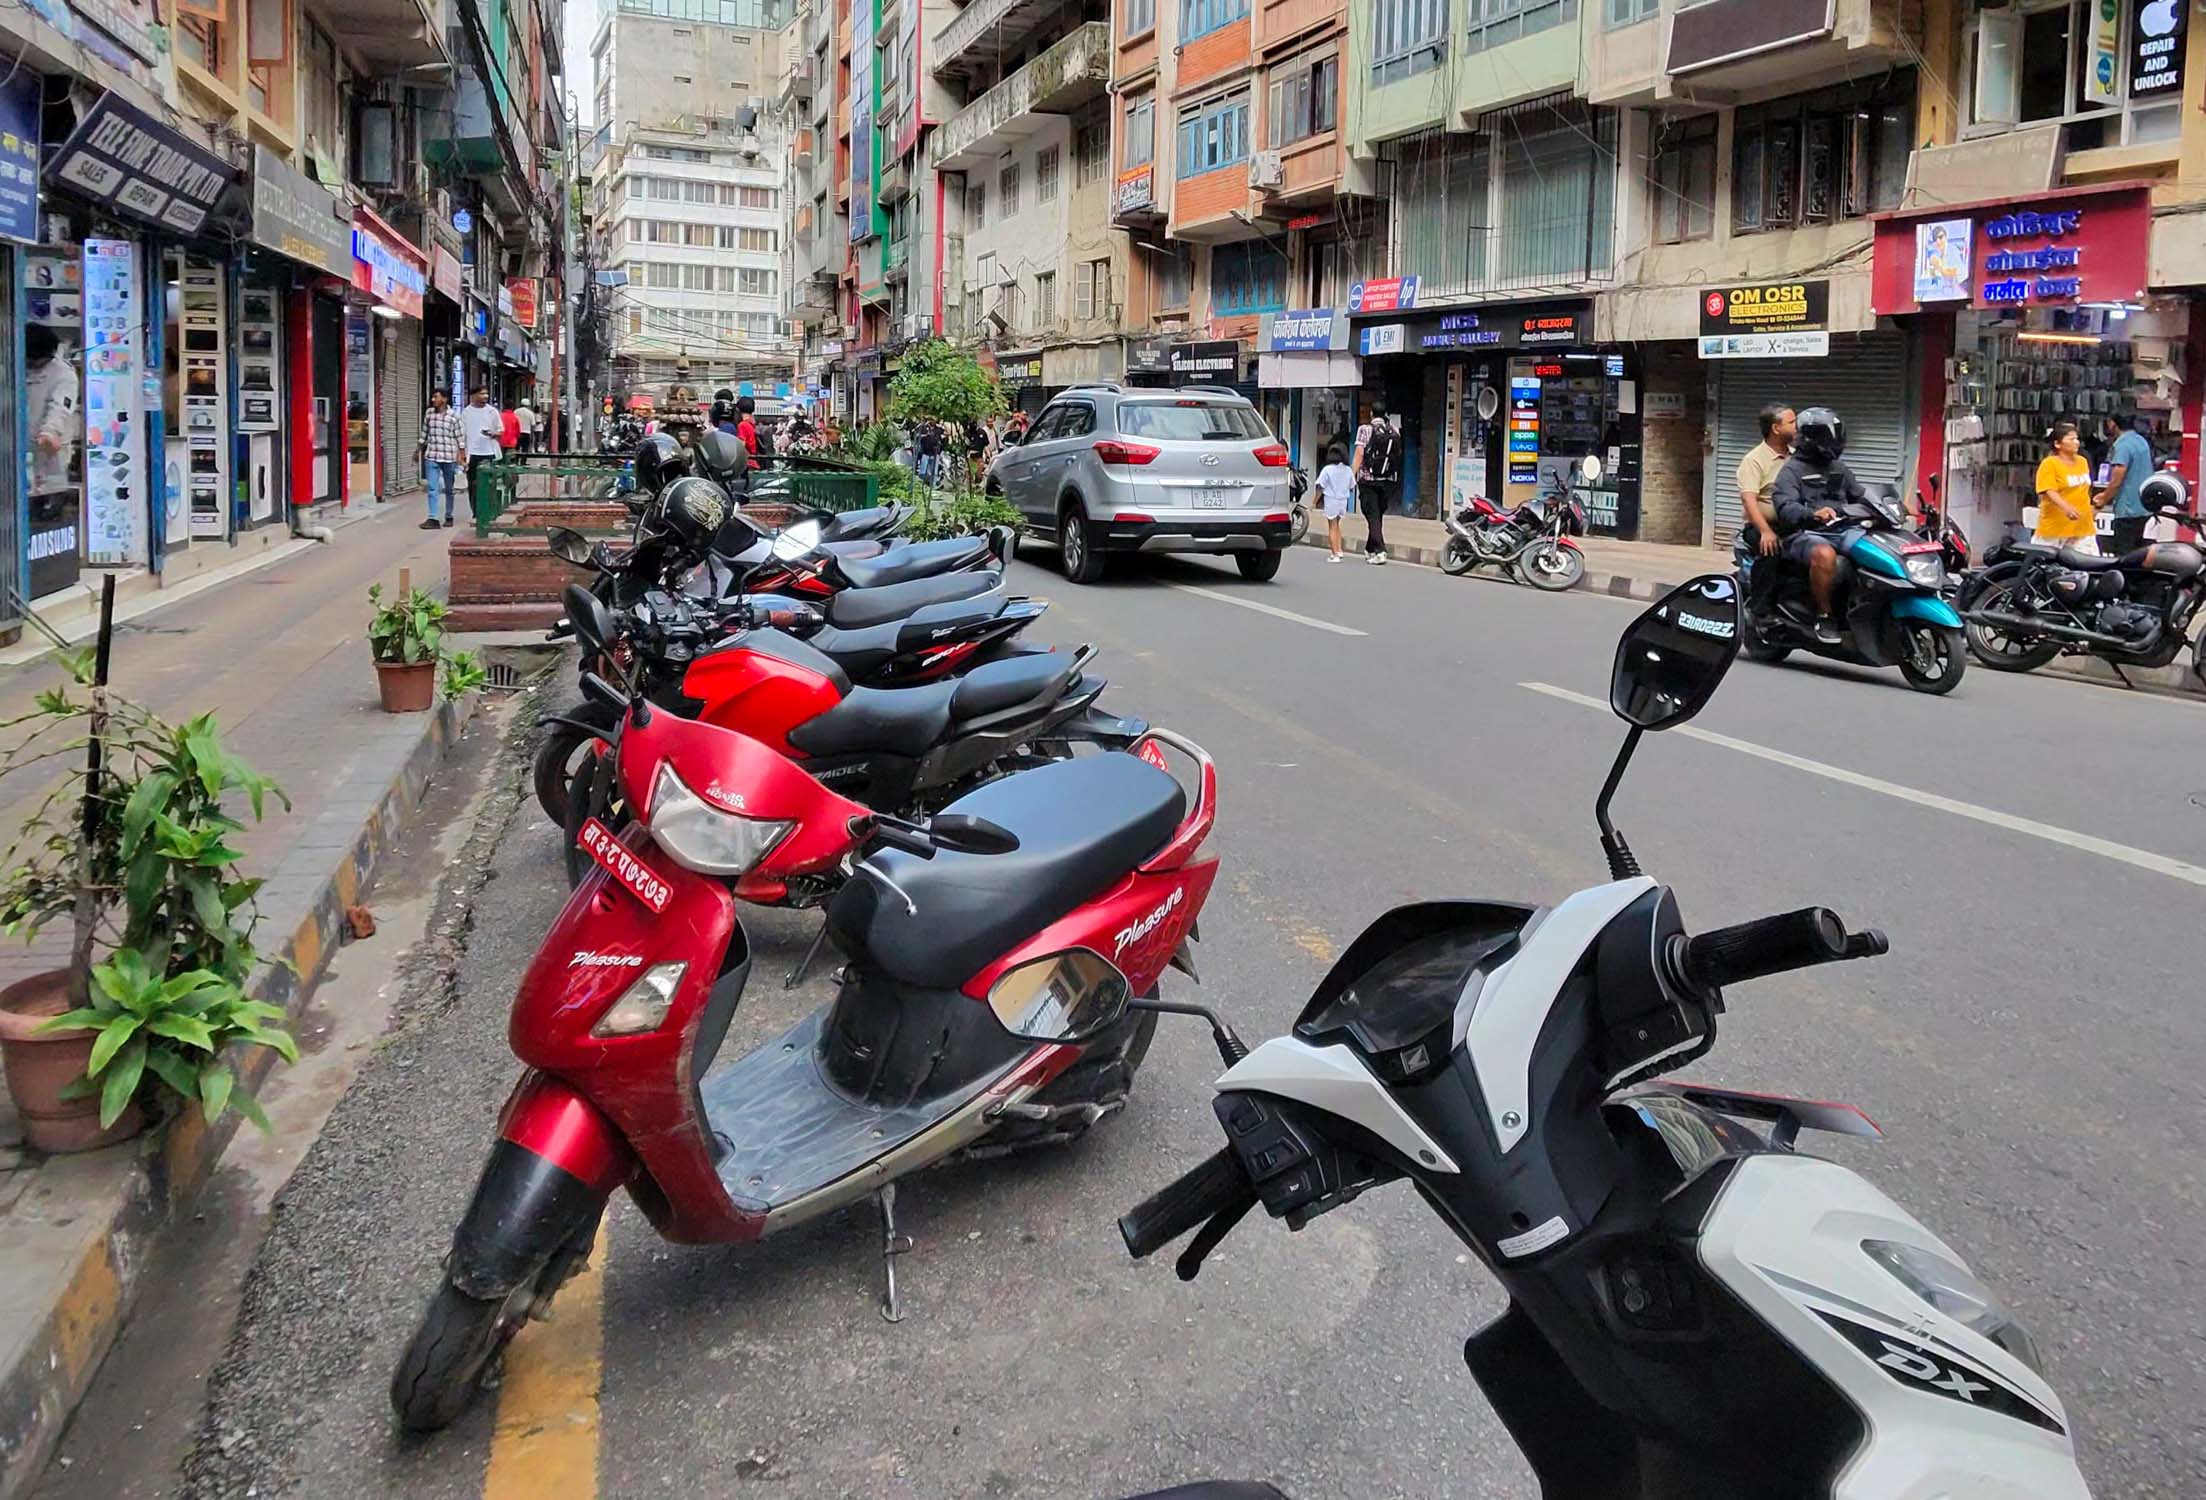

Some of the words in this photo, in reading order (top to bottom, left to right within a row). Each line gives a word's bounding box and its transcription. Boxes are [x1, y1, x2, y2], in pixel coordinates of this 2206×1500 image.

[2140, 37, 2175, 56] REPAIR
[2144, 56, 2168, 72] AND
[2134, 71, 2178, 91] UNLOCK
[87, 111, 134, 155] TELE
[76, 160, 108, 183] SALES
[1400, 280, 1414, 305] hp
[1730, 289, 1760, 304] OM
[1765, 285, 1805, 302] OSR
[1730, 302, 1805, 315] ELECTRONICS
[1514, 432, 1535, 440] oppo
[1516, 443, 1534, 451] vivo
[1511, 474, 1536, 482] NOKIA
[1113, 885, 1184, 960] Pleasure
[568, 951, 643, 969] Pleasure
